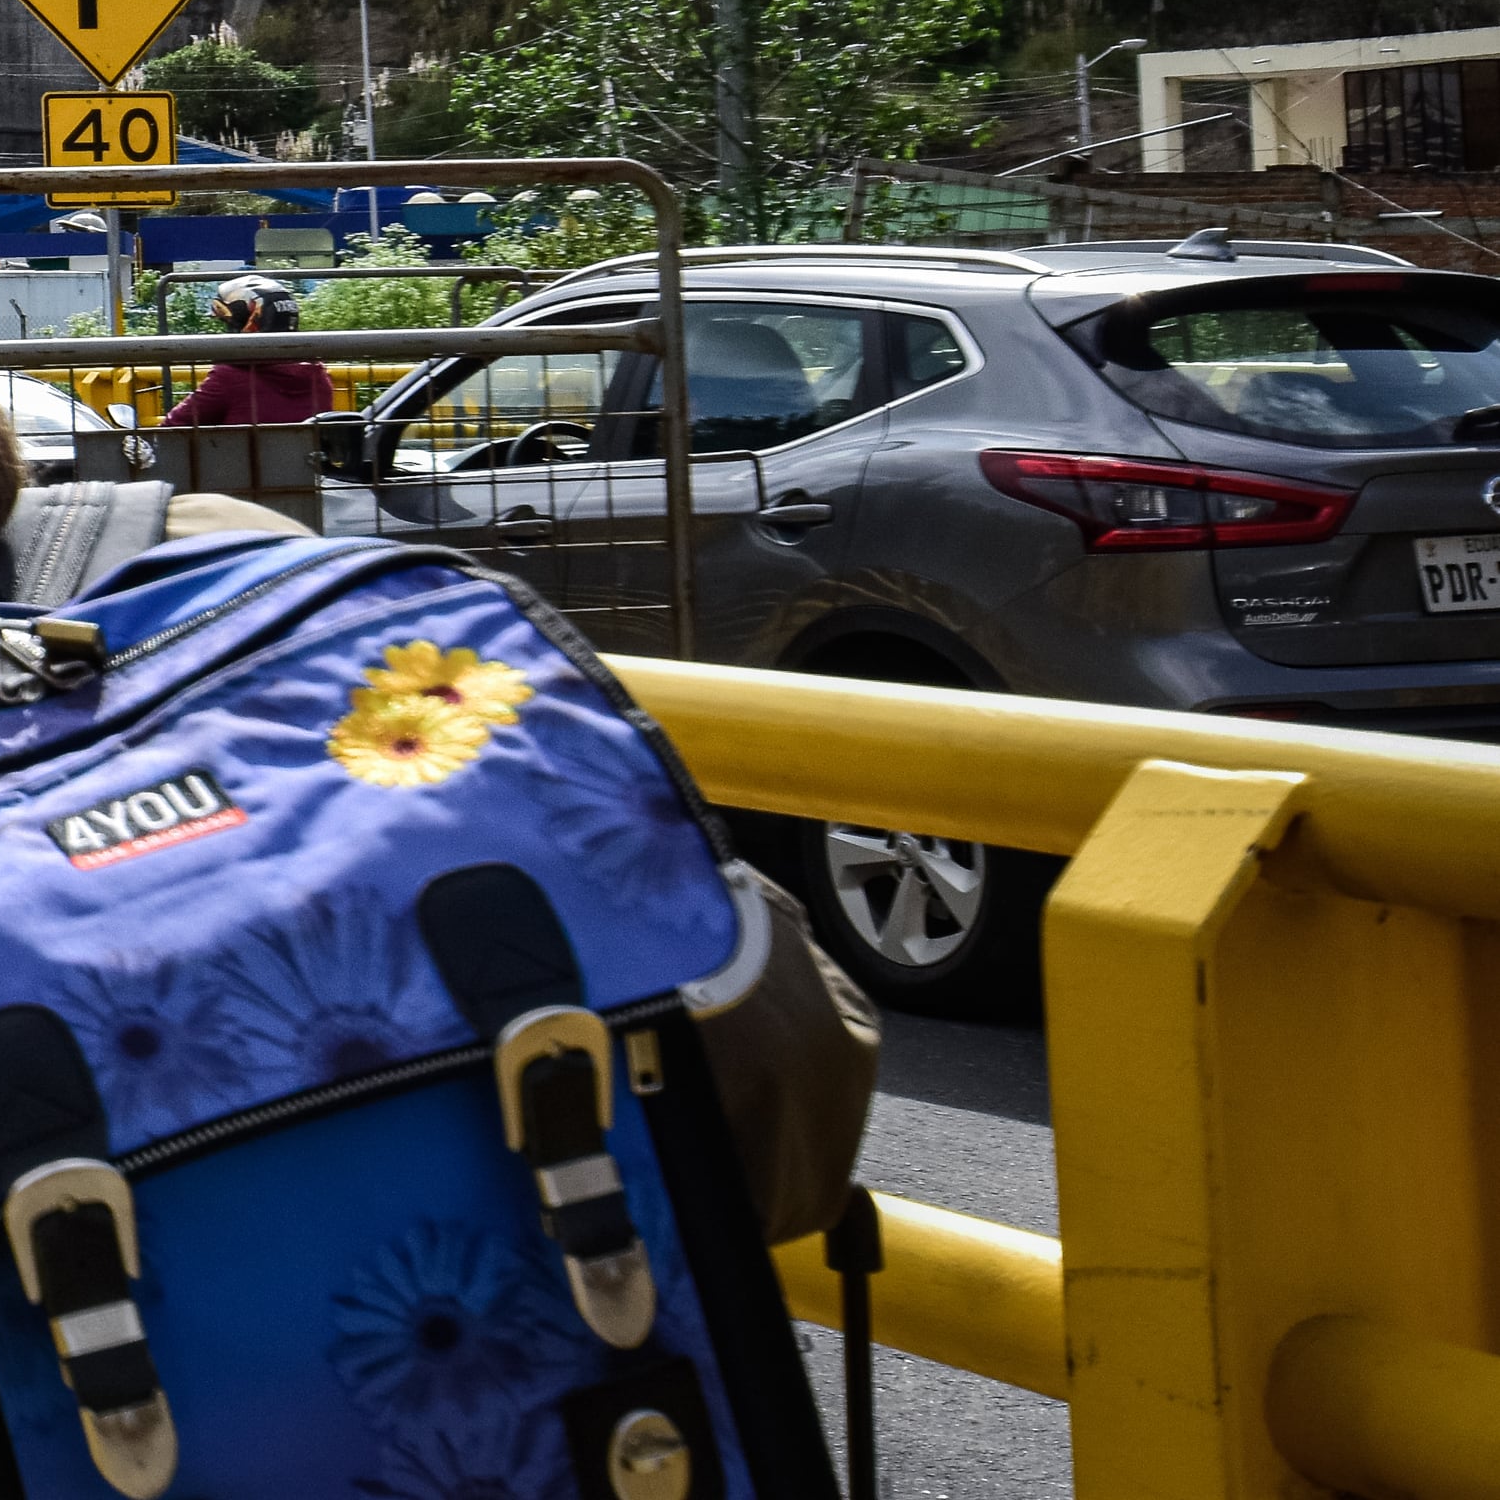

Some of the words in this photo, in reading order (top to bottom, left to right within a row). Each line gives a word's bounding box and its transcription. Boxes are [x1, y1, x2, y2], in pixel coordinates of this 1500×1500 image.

[62, 107, 159, 163] 40
[1423, 561, 1500, 604] PDR-
[64, 774, 219, 849] 4YOU
